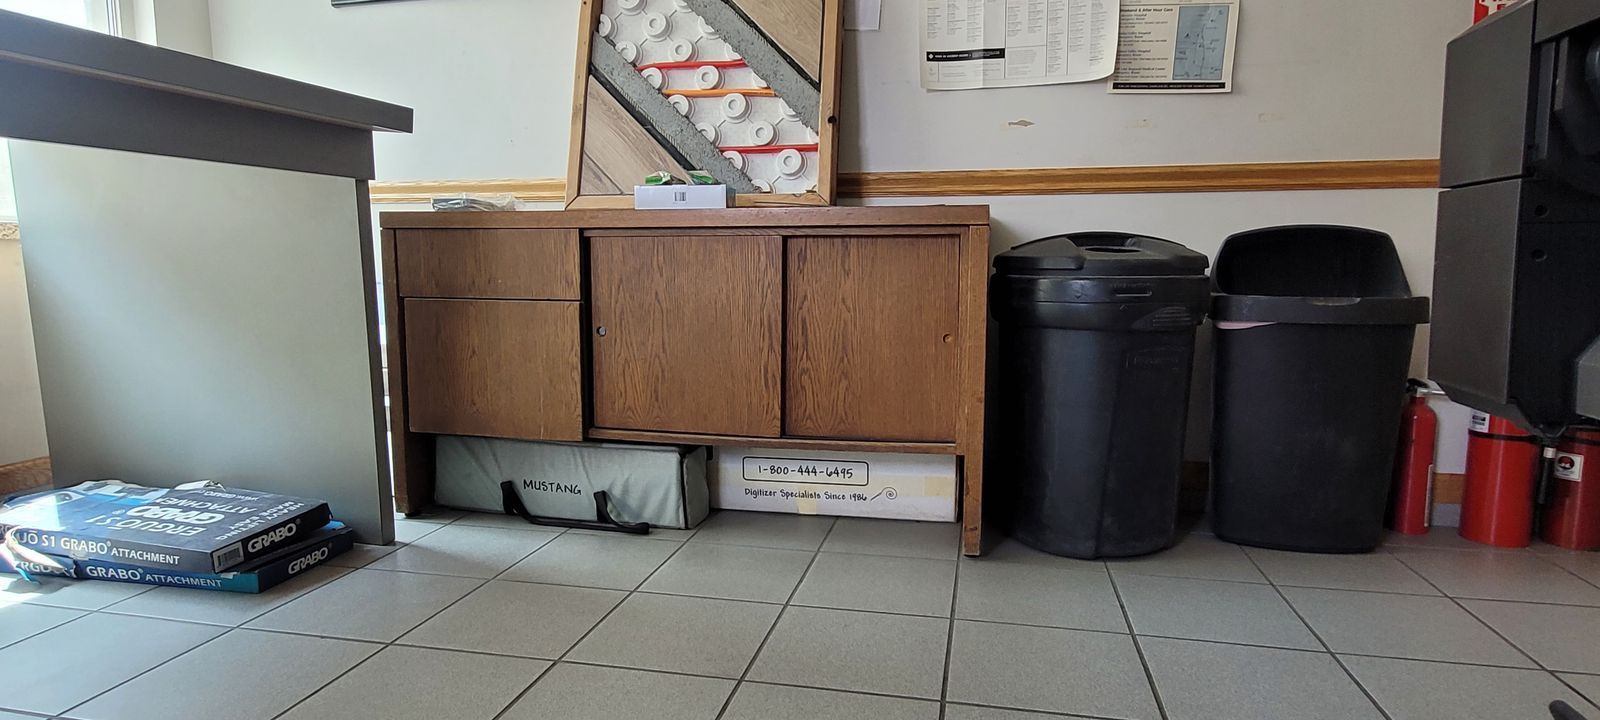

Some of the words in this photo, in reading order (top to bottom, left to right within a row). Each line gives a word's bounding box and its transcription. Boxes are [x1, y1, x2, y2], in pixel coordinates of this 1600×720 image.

[758, 464, 853, 479] 1-800-444-6495
[523, 479, 582, 495] MUSTANG
[744, 488, 777, 500] Digitizer
[779, 489, 821, 501] Specialists
[824, 490, 846, 501] Since
[849, 492, 868, 502] 1986
[266, 502, 305, 521] HEAVY
[215, 520, 266, 541] LIFTING
[247, 523, 297, 553] GRABO
[41, 534, 56, 548] S1
[111, 547, 180, 565] ATTACHMENT
[288, 547, 329, 575] GRABO
[145, 573, 223, 588] ATTACHMENT
